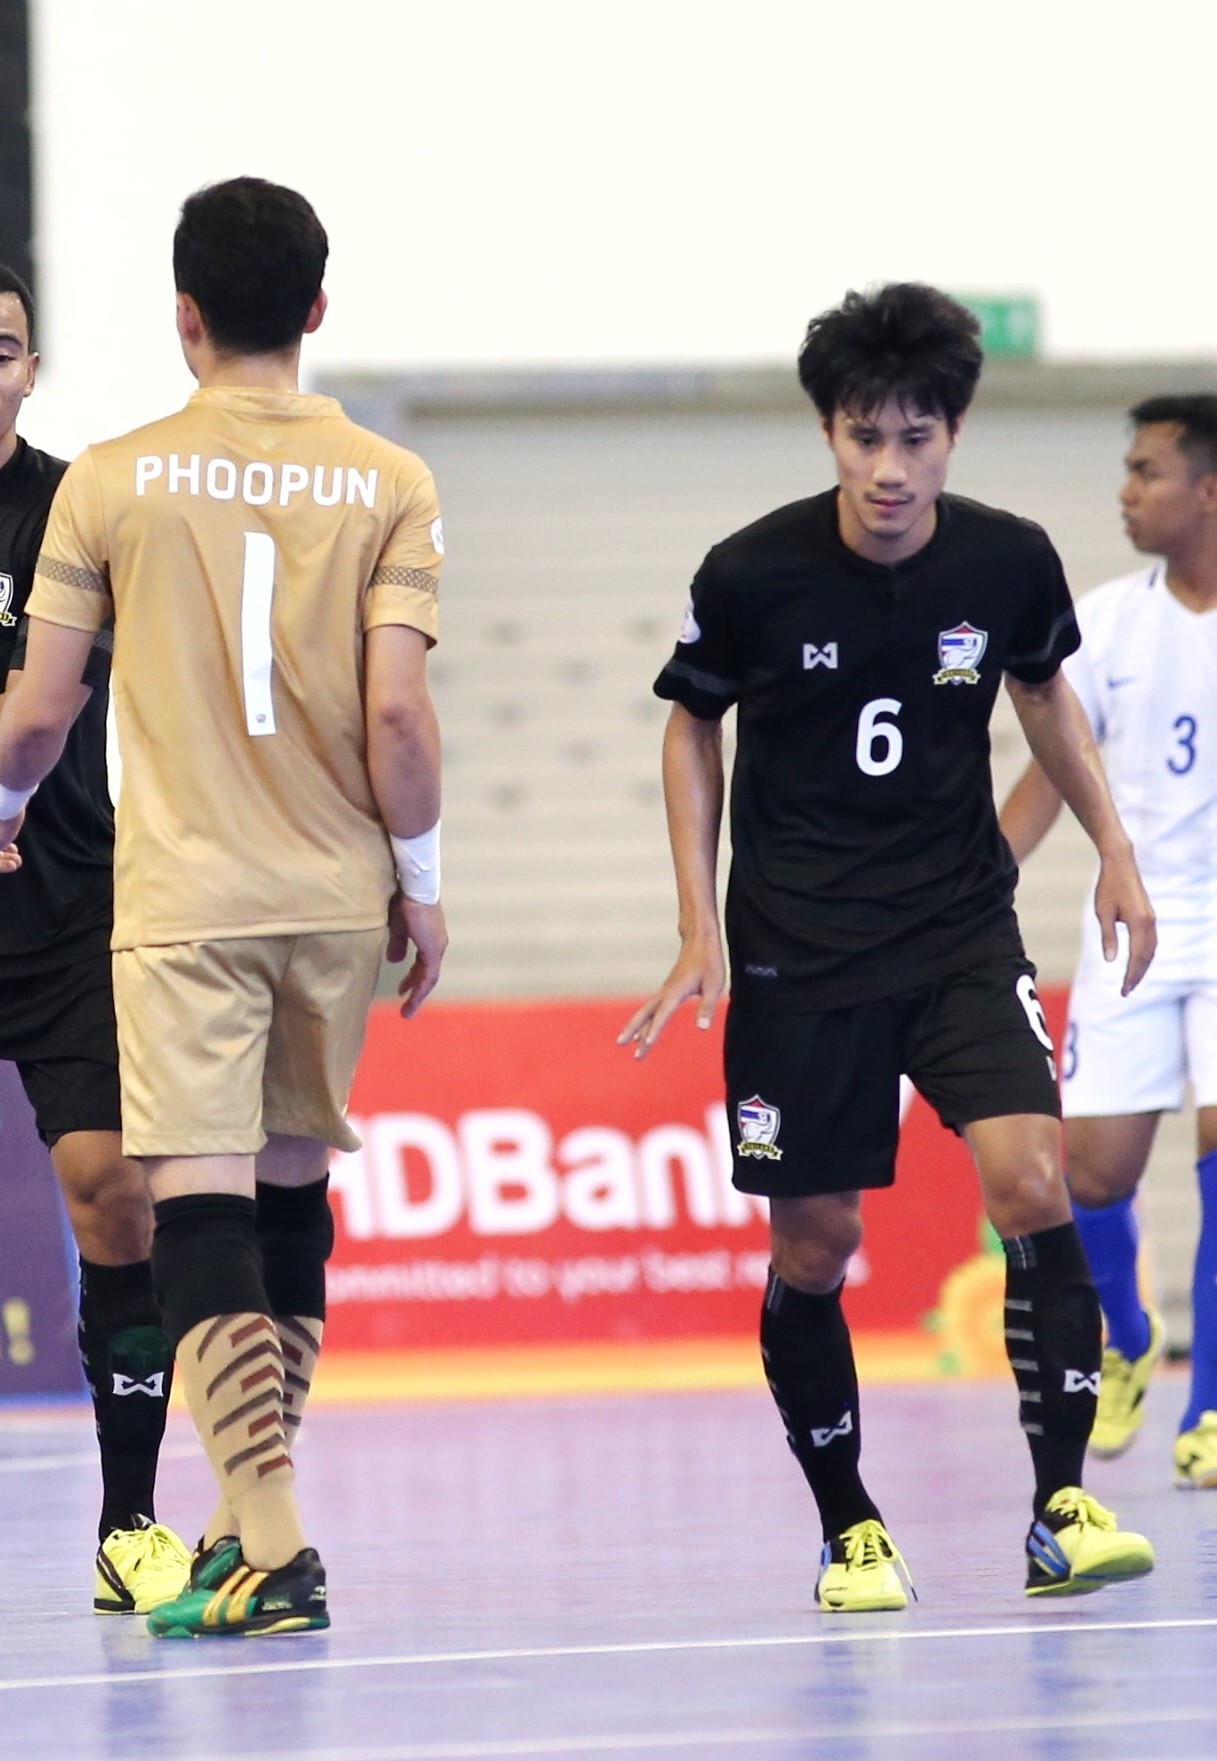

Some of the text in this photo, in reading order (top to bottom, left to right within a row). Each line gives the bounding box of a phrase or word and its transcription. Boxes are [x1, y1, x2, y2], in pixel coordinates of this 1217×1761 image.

[135, 453, 379, 508] PHOOPUN
[241, 531, 277, 737] 1
[855, 697, 904, 777] 6
[1167, 714, 1197, 775] 3
